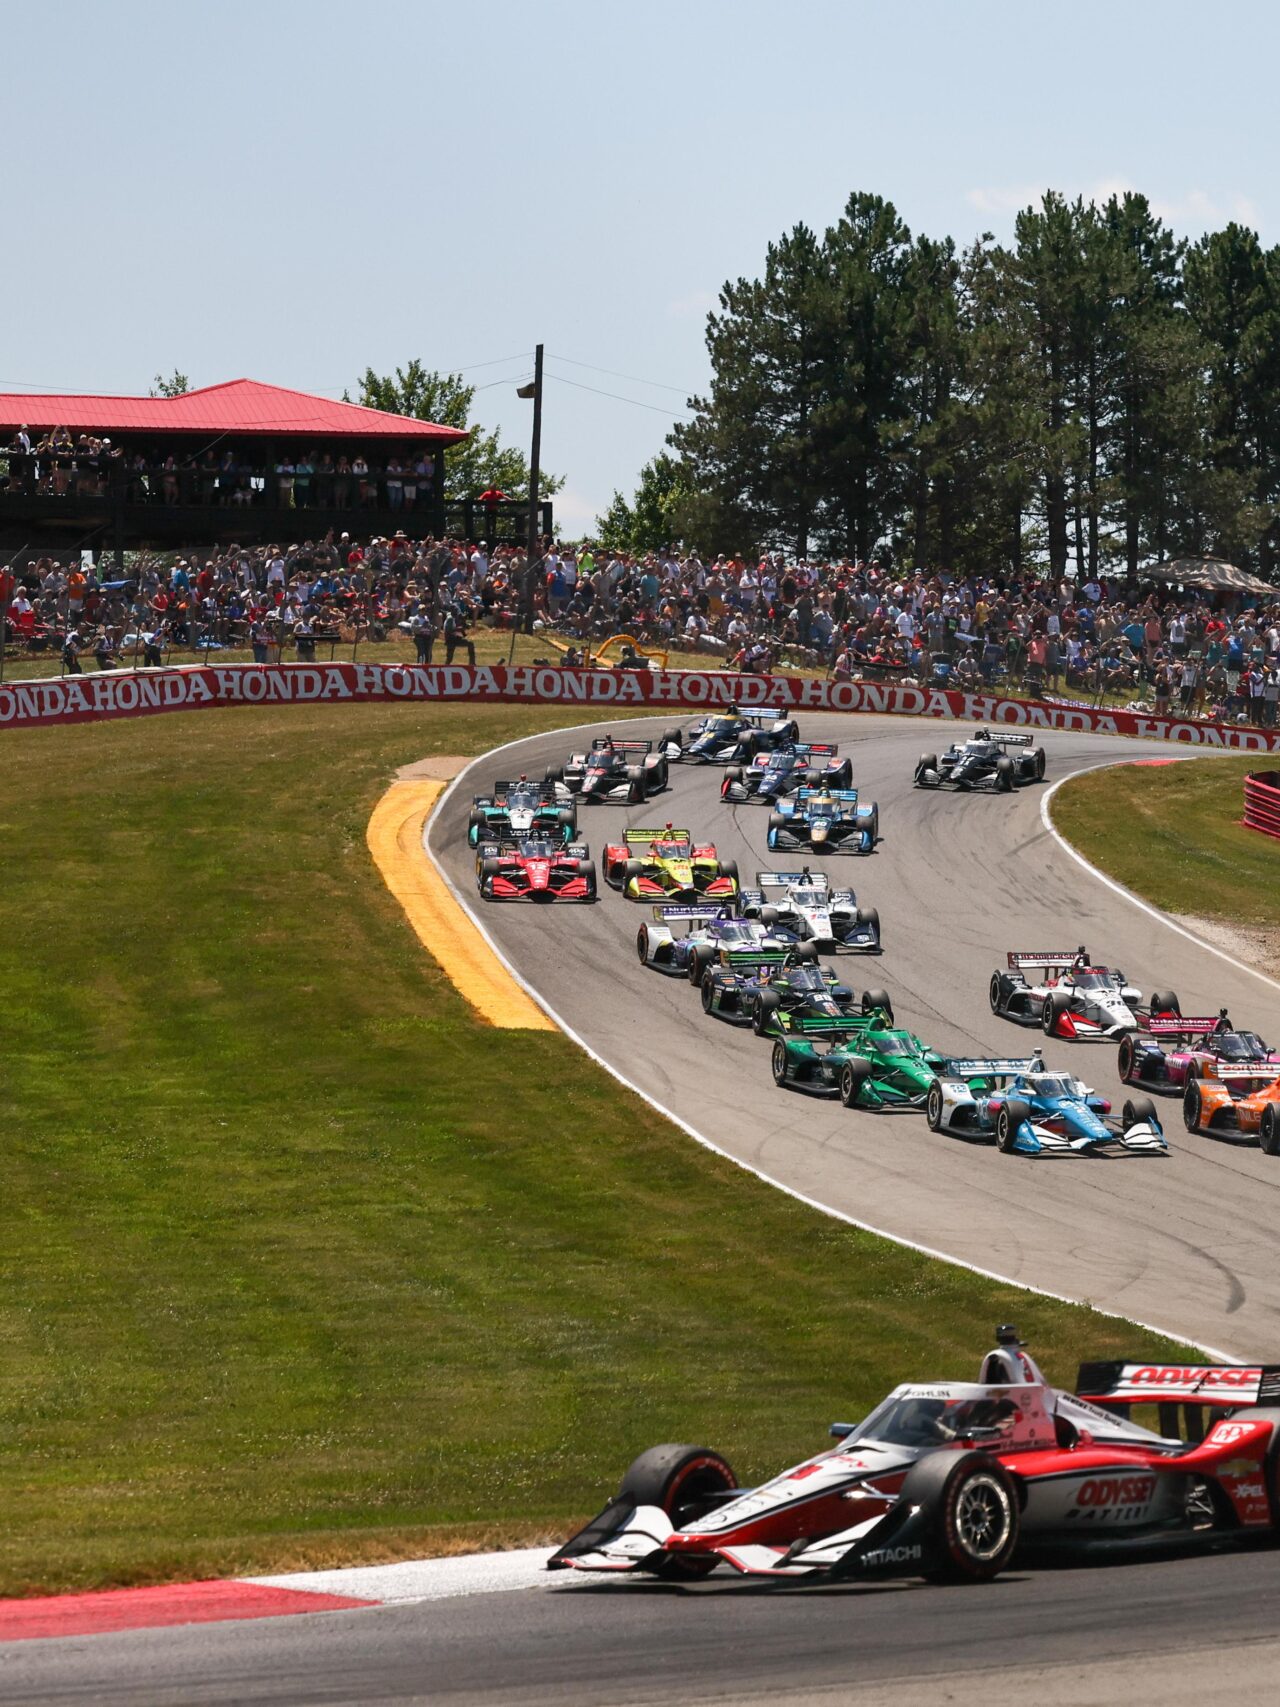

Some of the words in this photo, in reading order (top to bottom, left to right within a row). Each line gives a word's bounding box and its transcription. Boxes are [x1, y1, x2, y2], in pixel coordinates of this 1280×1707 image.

[90, 672, 213, 713] HONDA
[214, 668, 353, 701] HONDA
[353, 665, 500, 696] HONDA
[503, 669, 644, 701] HONDA
[650, 671, 800, 705] HONDA
[800, 678, 959, 719] HONDA
[961, 693, 1119, 733] HONDA
[861, 1544, 921, 1567] HITACHI
